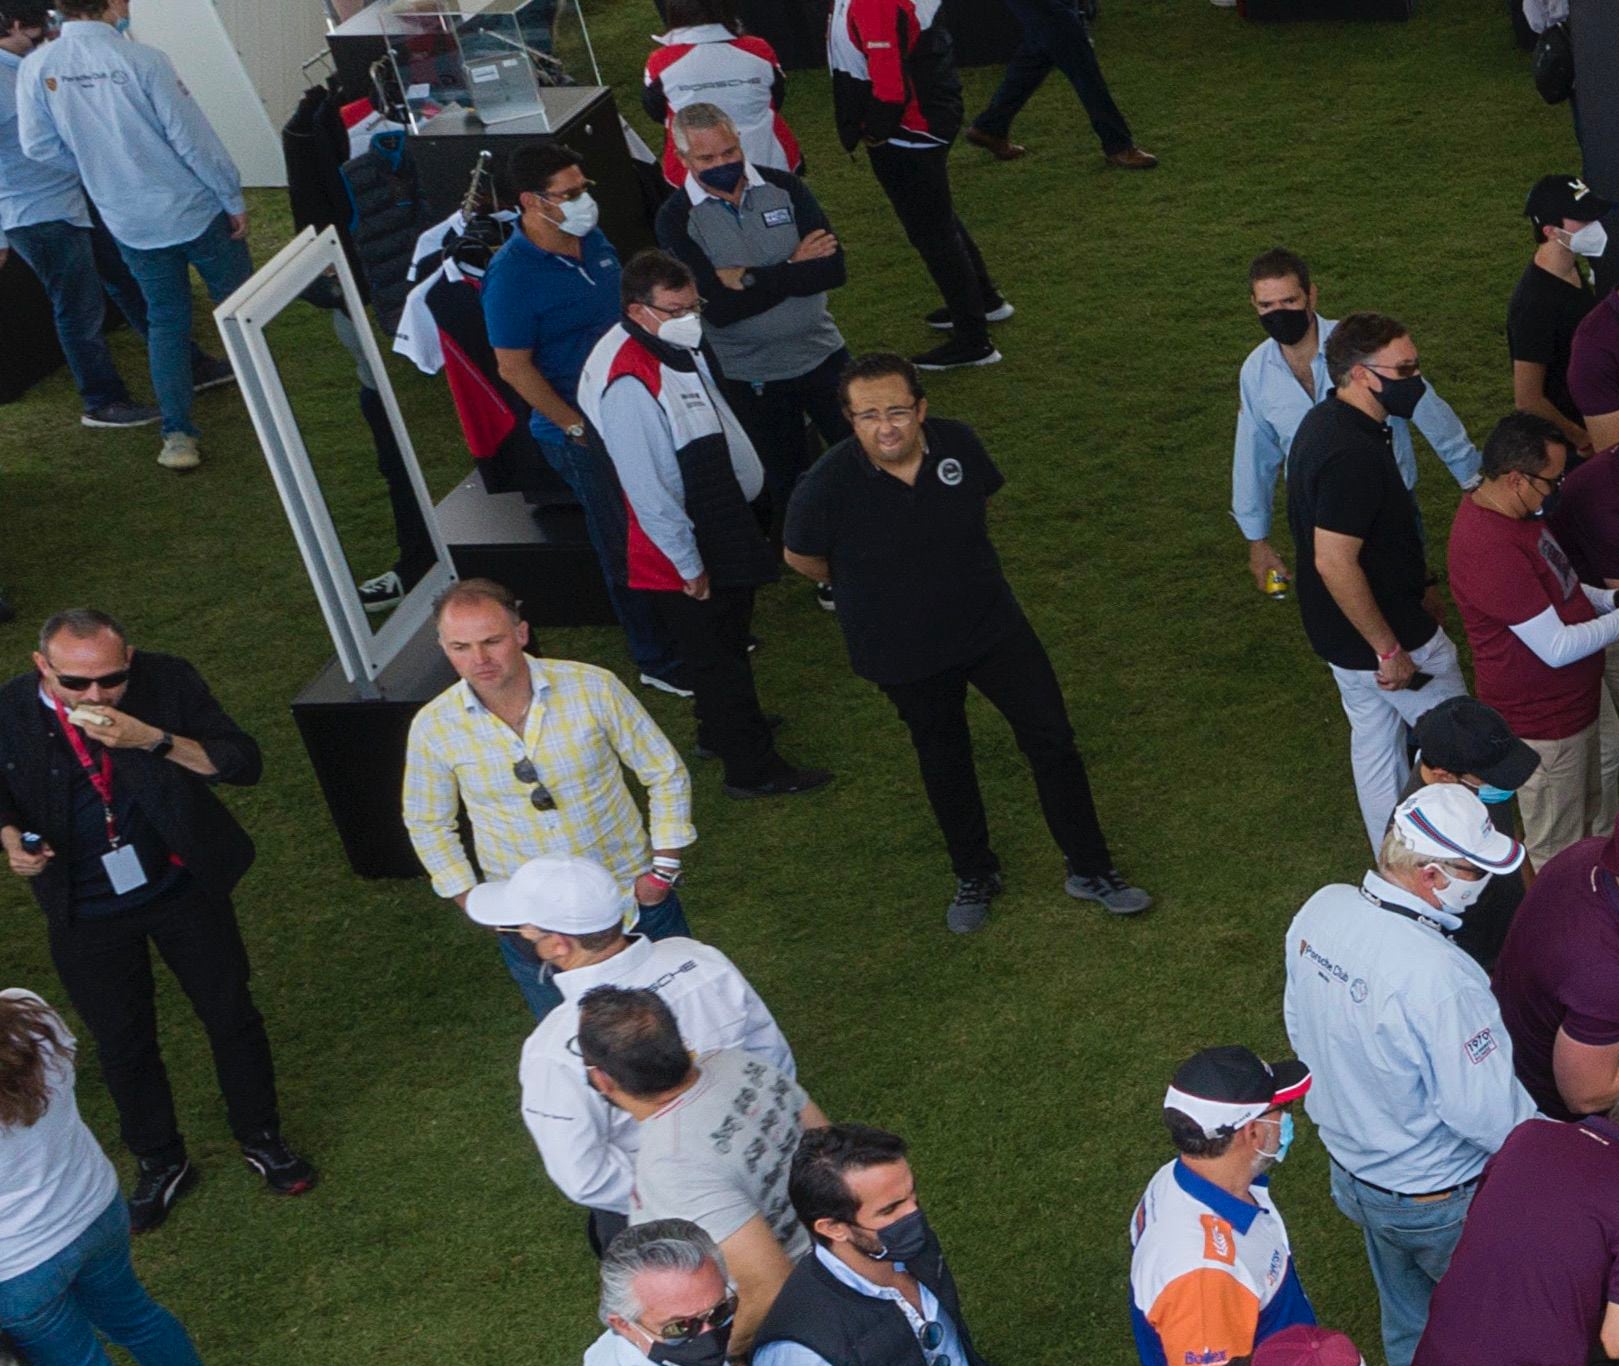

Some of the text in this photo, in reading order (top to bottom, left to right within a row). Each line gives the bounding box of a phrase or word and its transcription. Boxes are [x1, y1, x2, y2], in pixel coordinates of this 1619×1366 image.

[679, 77, 762, 92] PORSCHE
[1306, 945, 1332, 972] Porsche
[1333, 965, 1349, 982] Club
